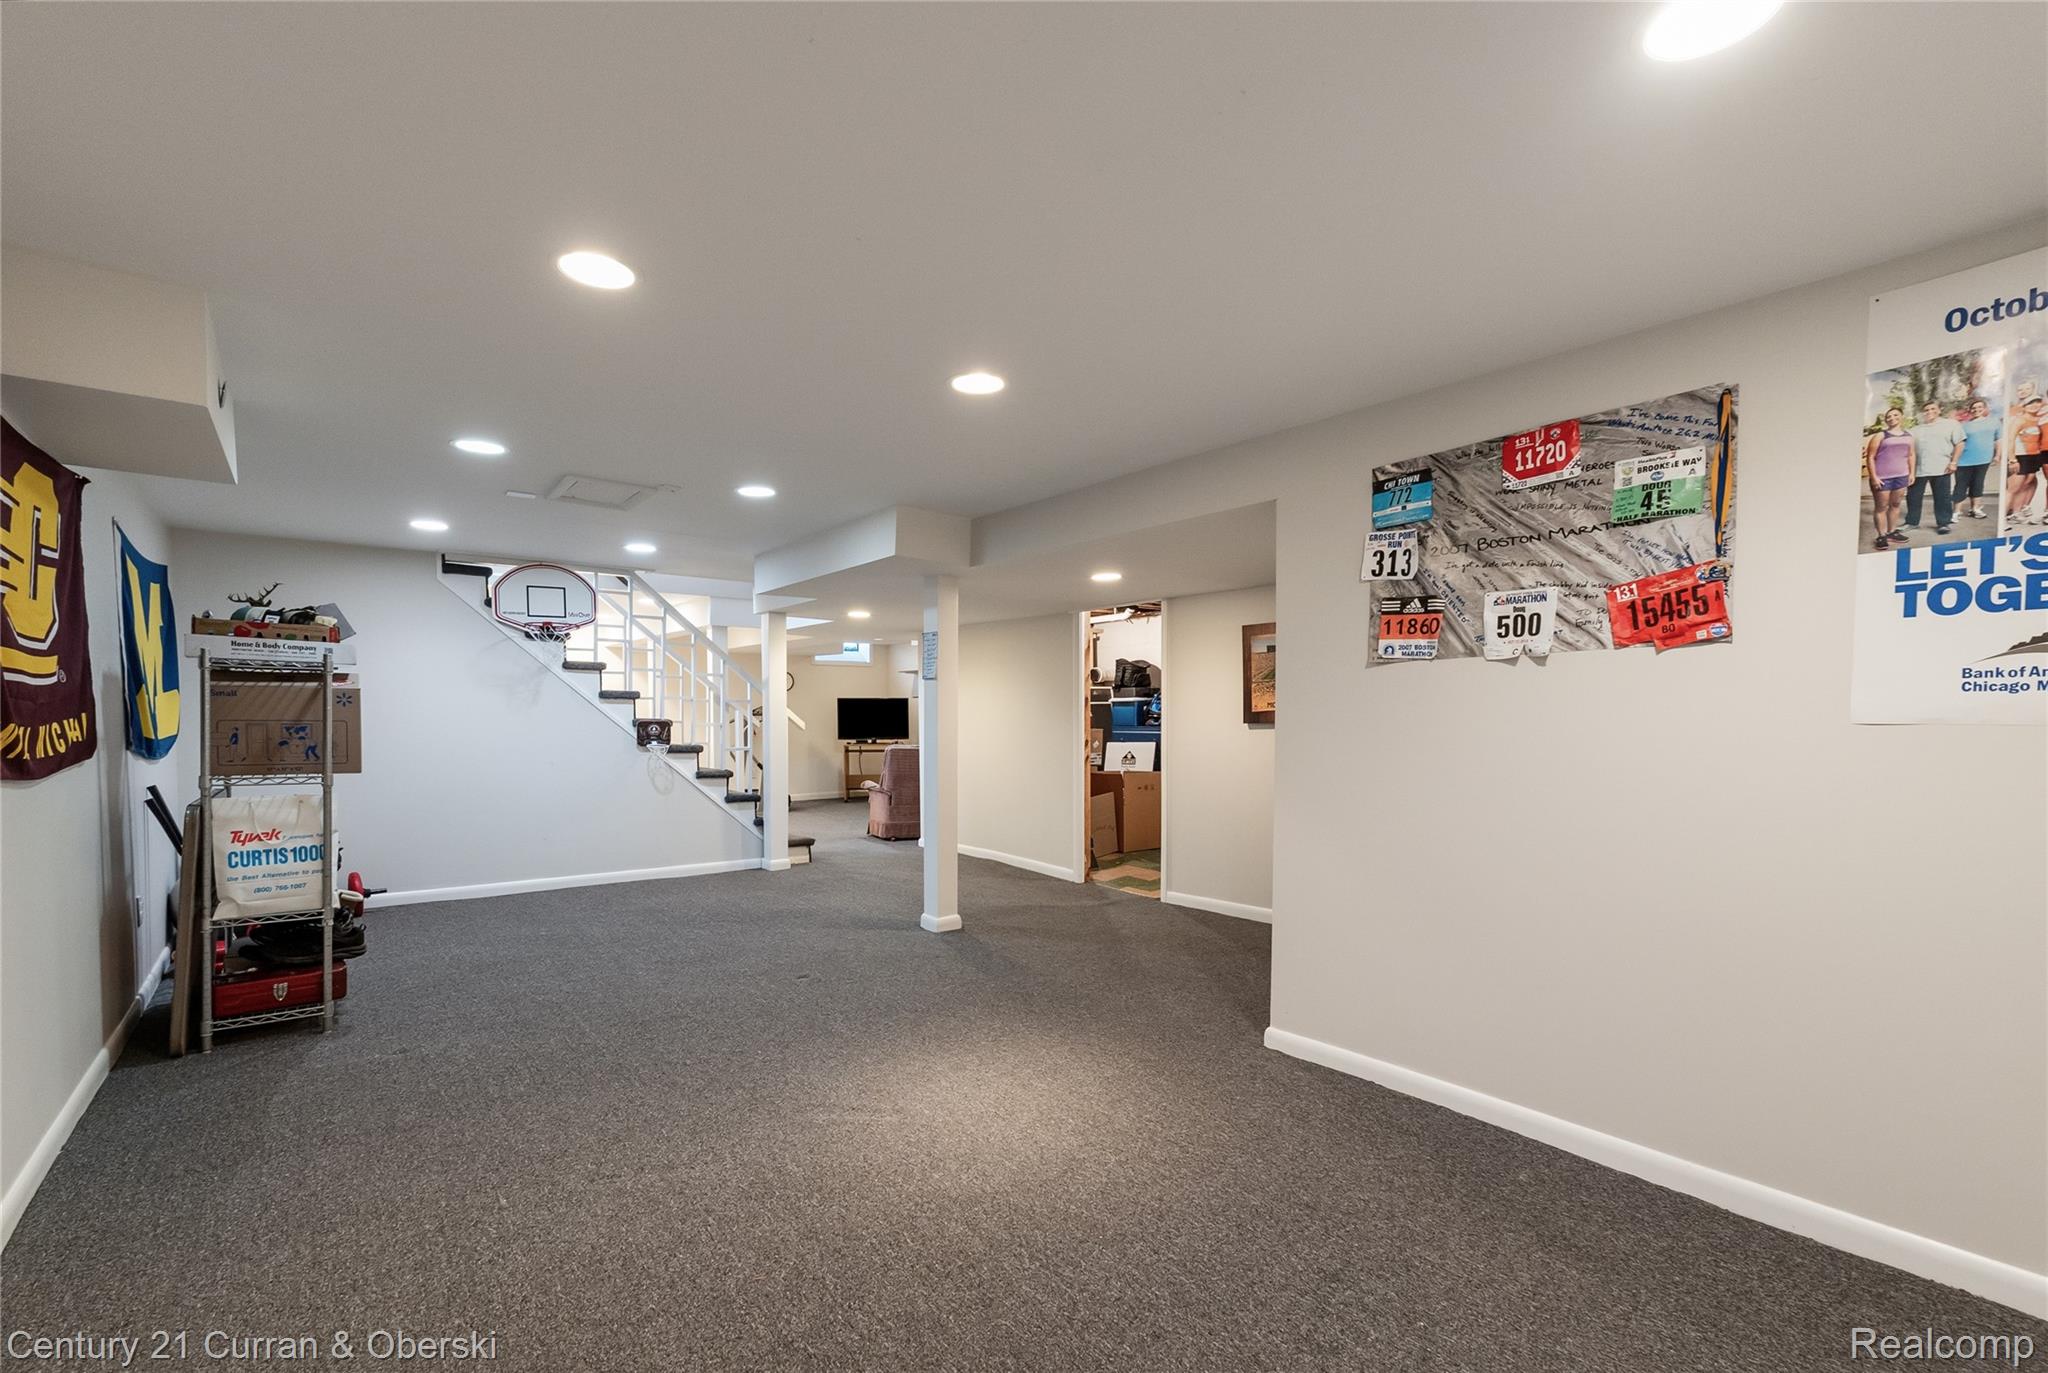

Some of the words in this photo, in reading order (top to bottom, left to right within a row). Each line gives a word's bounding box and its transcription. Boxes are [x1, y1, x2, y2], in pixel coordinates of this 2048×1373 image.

[1515, 440, 1567, 472] 11720
[1384, 480, 1396, 490] CHI
[1398, 474, 1420, 486] TOWN
[1564, 479, 1603, 489] METAL
[1389, 487, 1412, 506] 772
[1641, 508, 1696, 517] MARATHON
[1369, 532, 1396, 541] GROSSE
[1430, 544, 1469, 557] 2007
[1477, 533, 1541, 551] BOSTON
[1371, 548, 1412, 577] 313
[1895, 532, 2048, 582] LET'S
[1505, 593, 1547, 604] MARATHON
[1614, 583, 1638, 600] 13.1
[1894, 572, 2048, 618] TOGE
[1627, 584, 1709, 630] 15455
[1383, 617, 1440, 635] 11860
[1497, 612, 1541, 638] 500
[231, 640, 254, 648] Home
[262, 642, 281, 650] Body
[283, 644, 317, 652] Company
[1961, 667, 2005, 679] Bank
[2007, 666, 2027, 678] of
[210, 689, 239, 697] Small
[1961, 681, 2031, 694] Chicago
[227, 847, 288, 869] CURTIS
